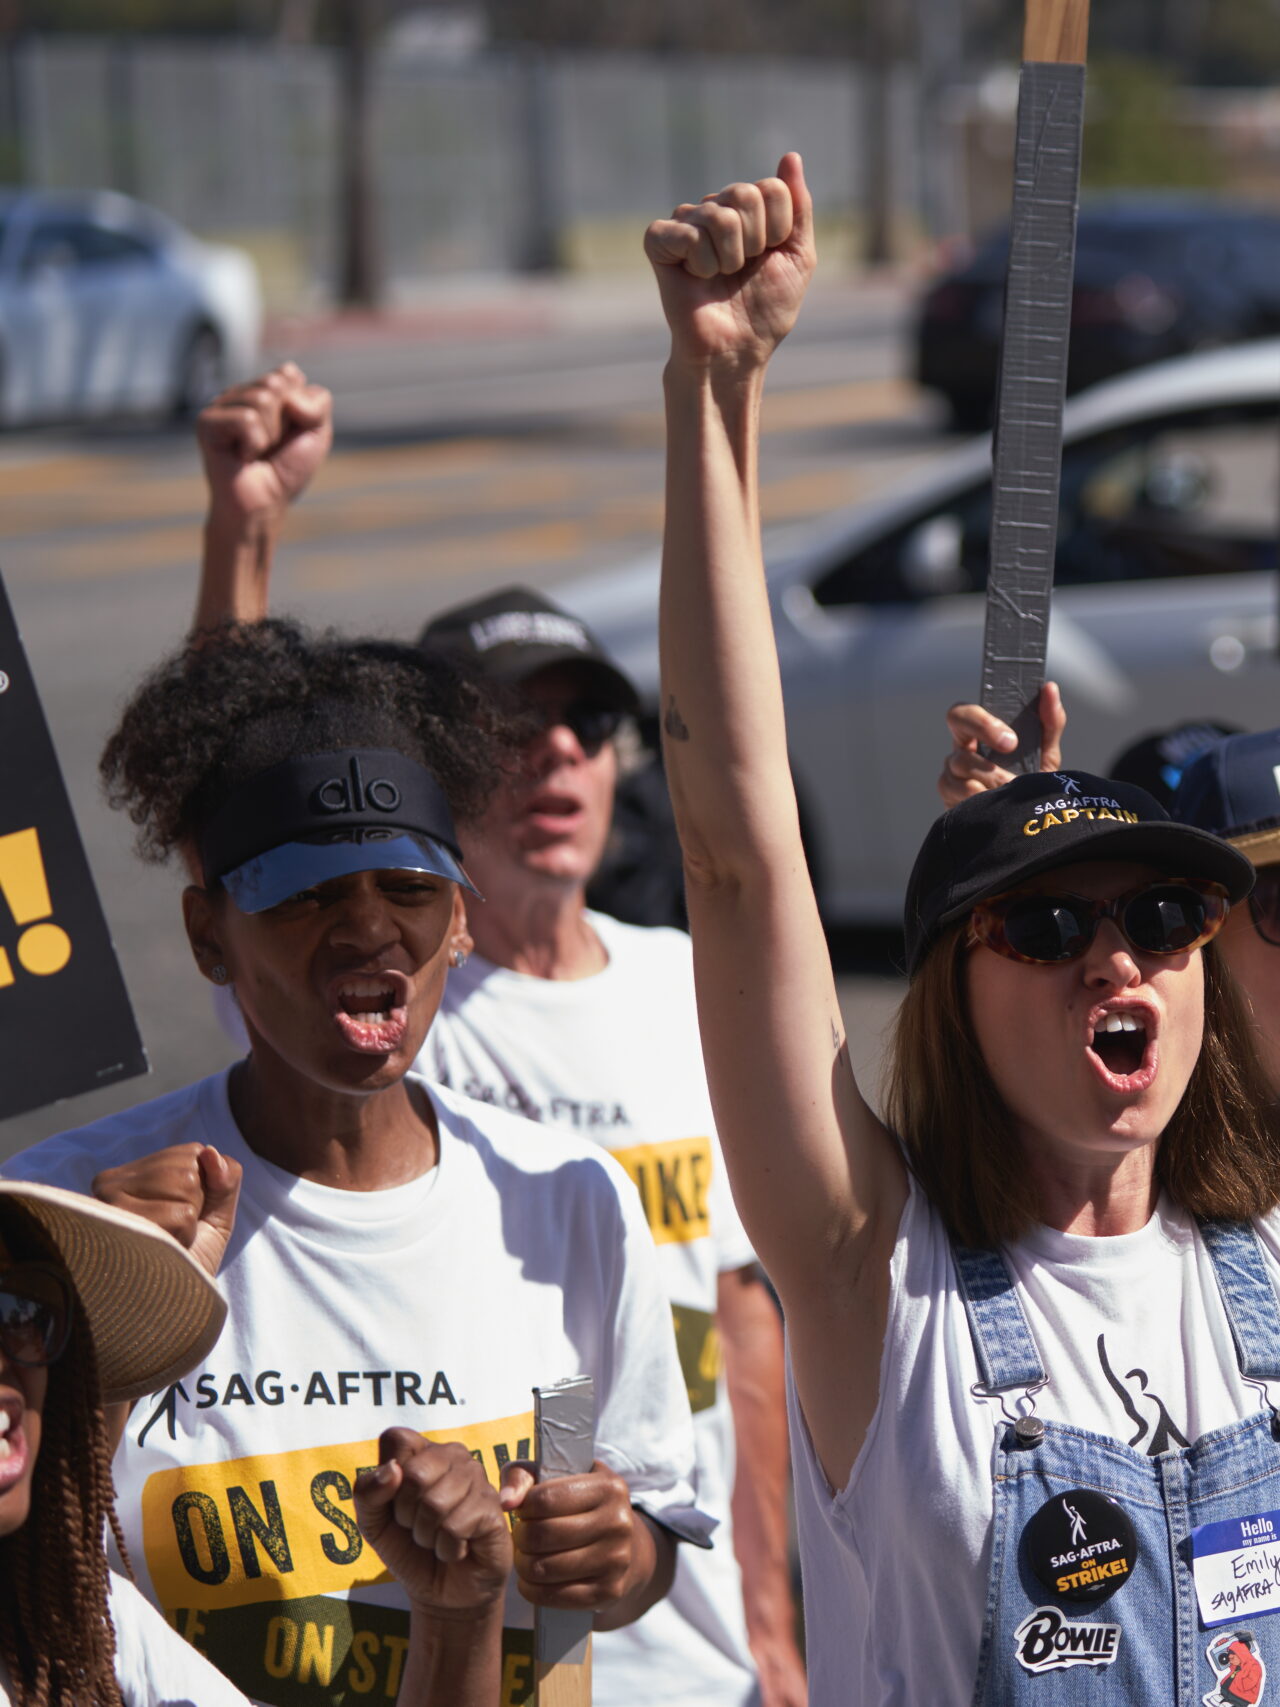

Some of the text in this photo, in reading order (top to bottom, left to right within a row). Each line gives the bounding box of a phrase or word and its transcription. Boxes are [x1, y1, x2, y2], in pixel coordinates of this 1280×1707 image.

[312, 757, 401, 814] alo
[1023, 807, 1139, 837] CAPTAIN
[172, 1480, 294, 1586] ON
[1240, 1518, 1274, 1538] Hello
[1242, 1532, 1278, 1547] my name is
[1056, 1558, 1129, 1592] STRIKE!
[1081, 1558, 1097, 1569] ON
[265, 1616, 335, 1687] ON
